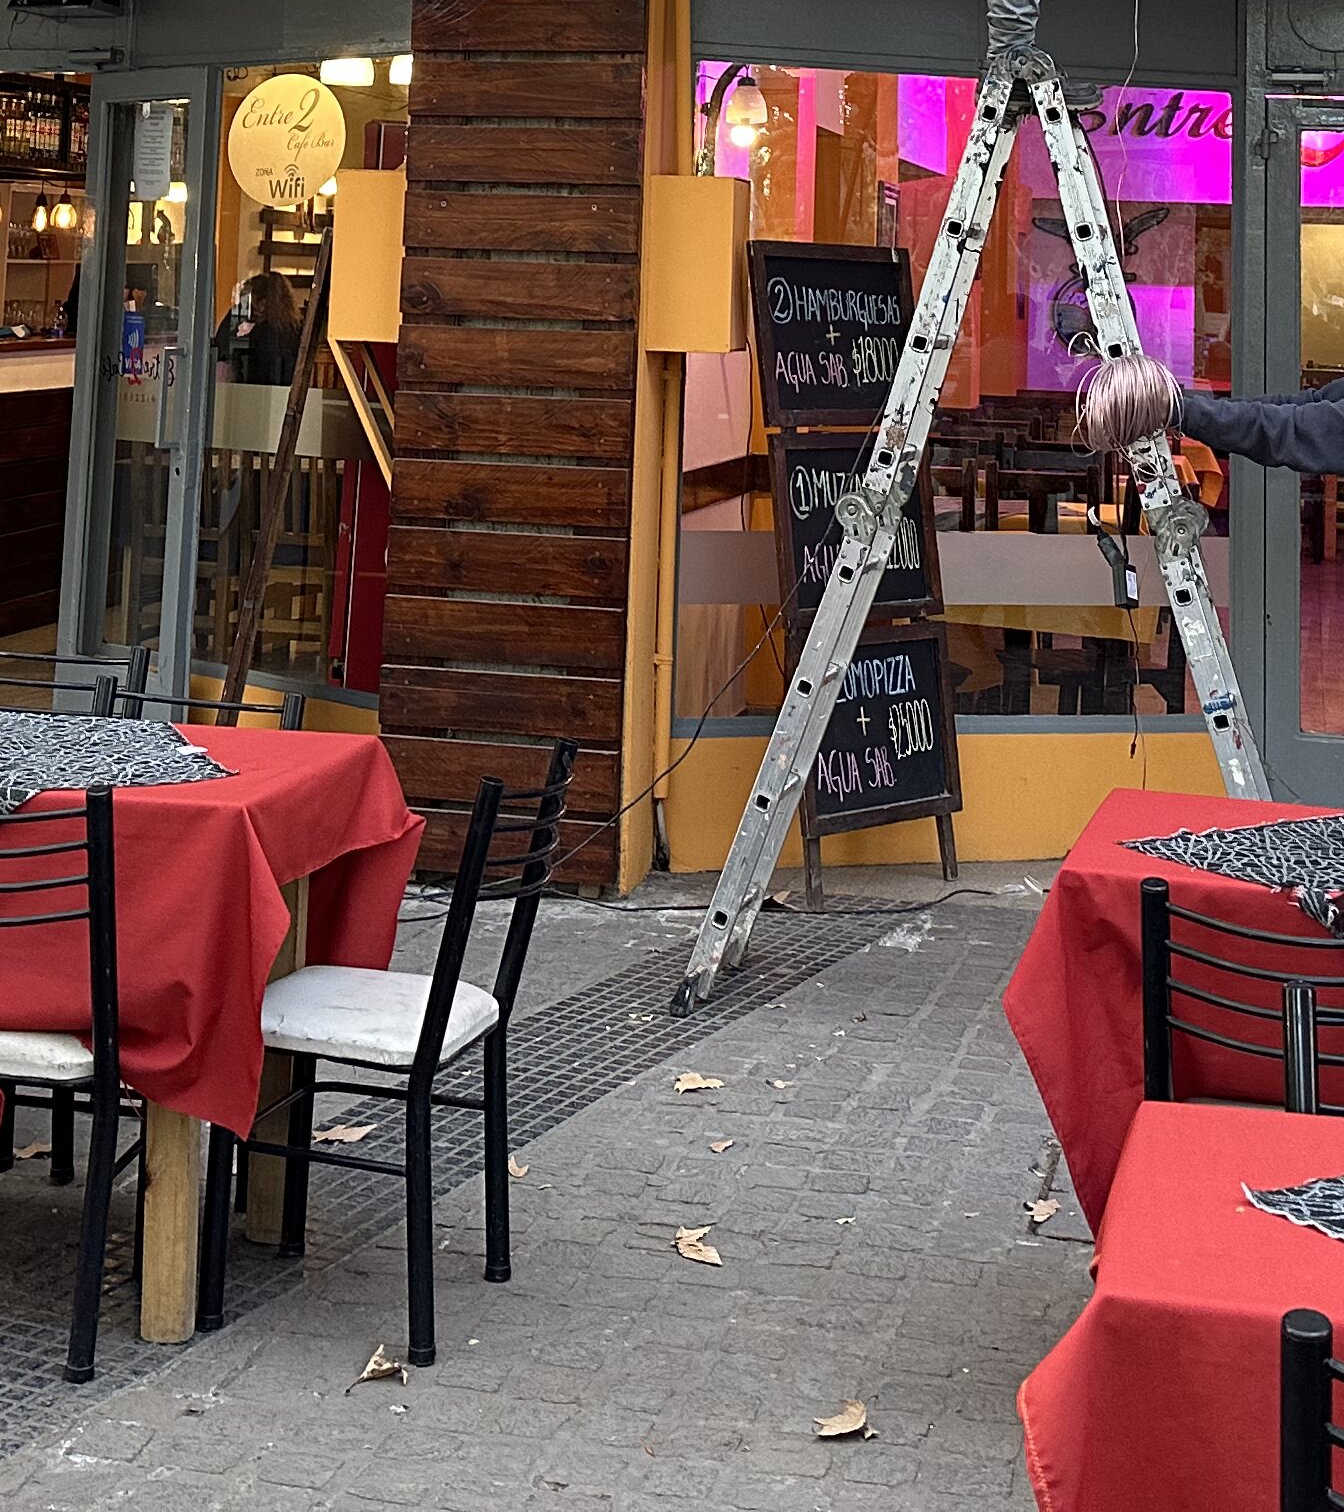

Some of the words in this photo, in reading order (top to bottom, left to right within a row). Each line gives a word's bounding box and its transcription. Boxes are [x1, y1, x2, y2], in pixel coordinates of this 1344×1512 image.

[242, 96, 293, 129] Entre
[288, 88, 321, 133] 2
[269, 177, 305, 199] Wifi
[794, 285, 901, 331] HAMBURGUESAS
[776, 351, 817, 393] AGUA
[836, 654, 916, 703] OMOPIZZA
[818, 749, 863, 802] AGUA
[888, 698, 935, 760] $25000
